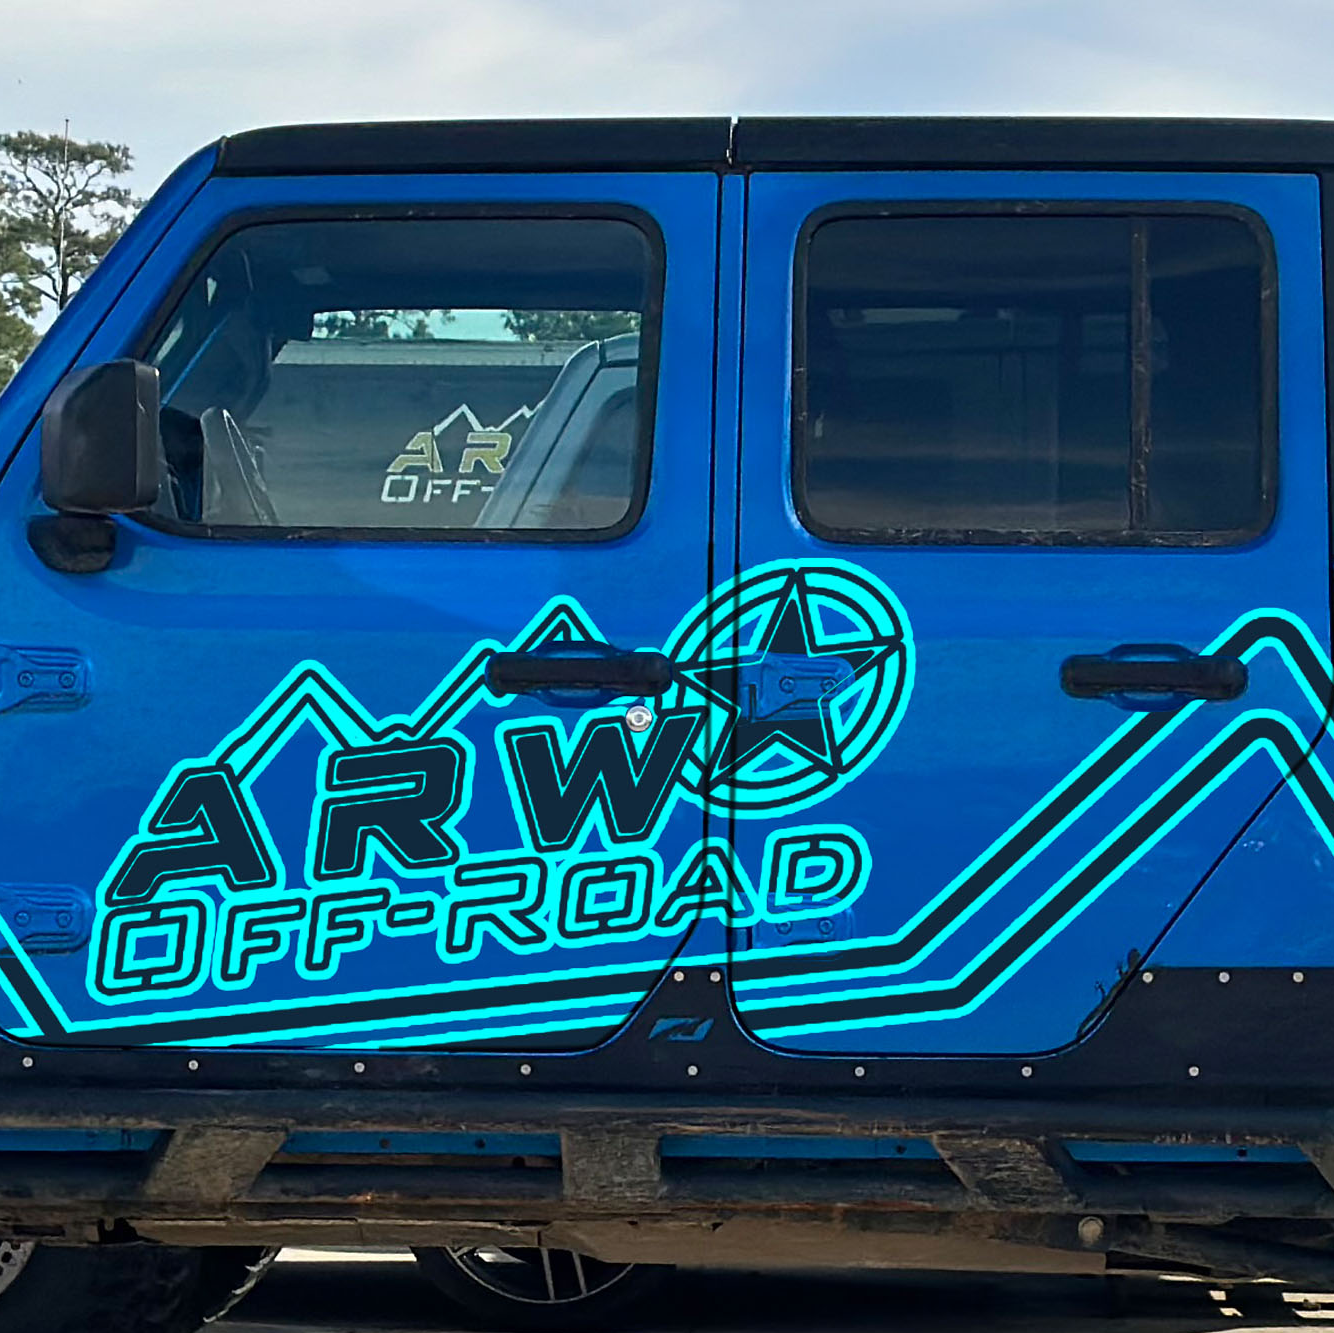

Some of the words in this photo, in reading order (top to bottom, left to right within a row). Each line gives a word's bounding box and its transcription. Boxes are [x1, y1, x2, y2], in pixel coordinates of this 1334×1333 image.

[385, 430, 513, 474] AR
[105, 704, 707, 902] ARW
[91, 829, 871, 996] OFF-ROAD
